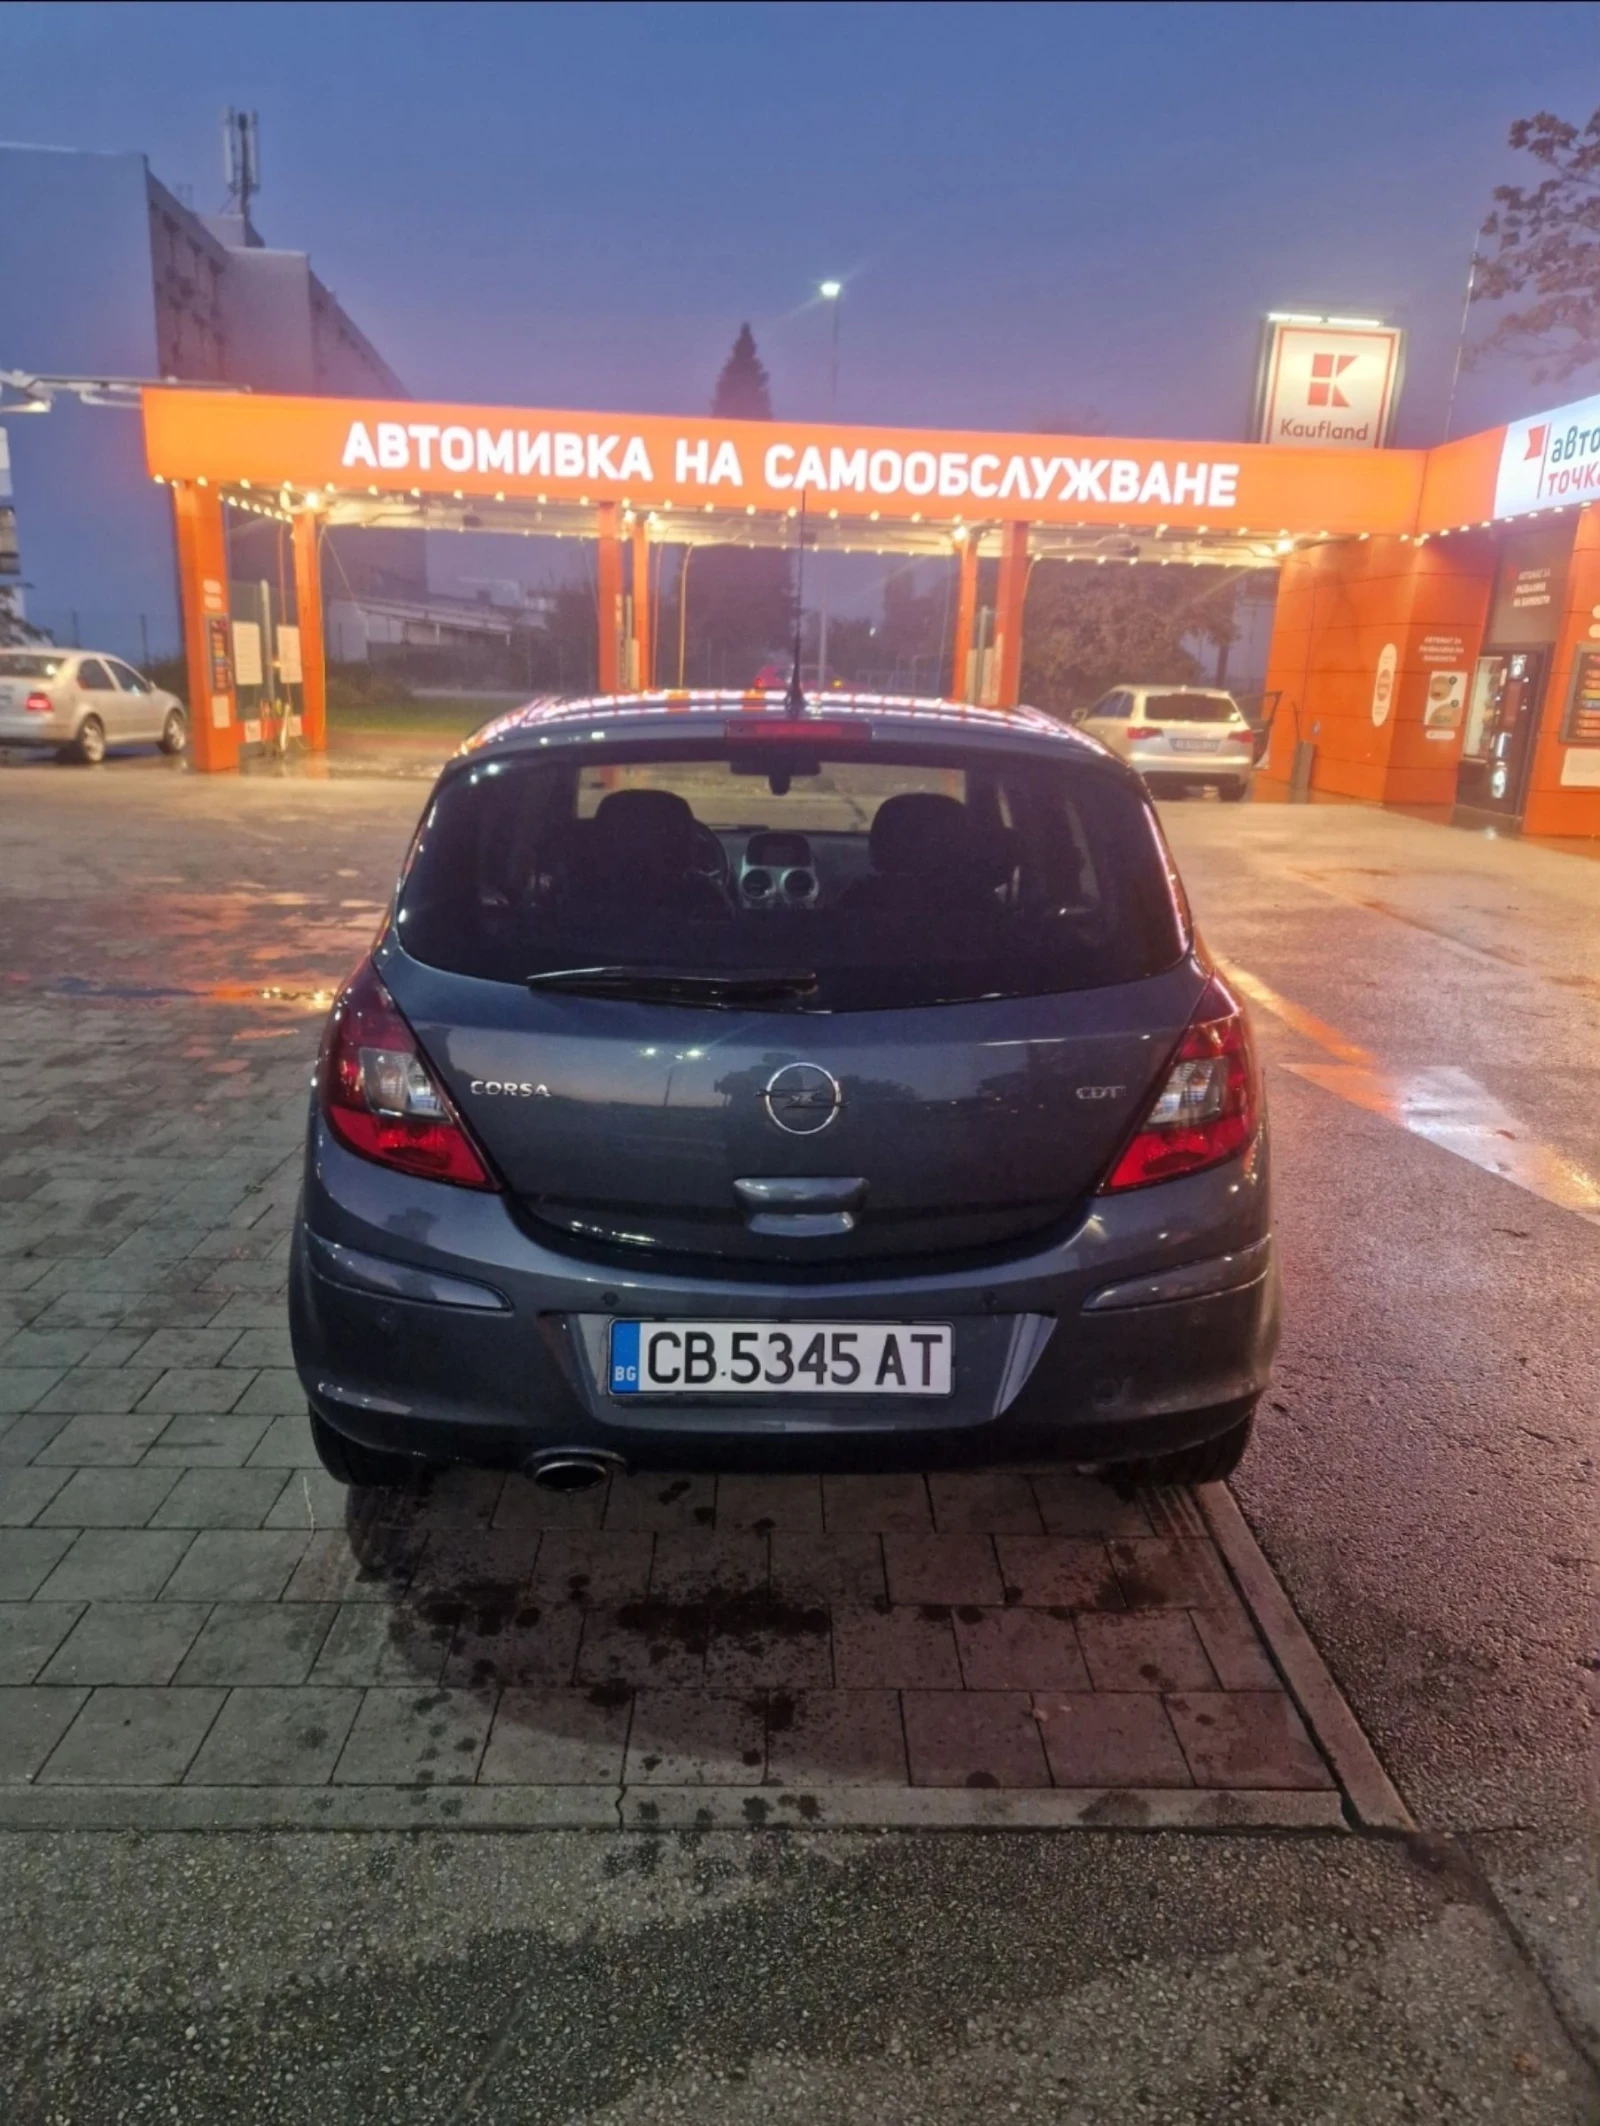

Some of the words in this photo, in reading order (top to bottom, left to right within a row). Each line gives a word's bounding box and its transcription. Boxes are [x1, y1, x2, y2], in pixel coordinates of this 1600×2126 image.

[1280, 418, 1369, 441] Kaufland
[342, 420, 654, 482] АВТОМИВКА
[675, 438, 744, 487] НА
[764, 443, 1240, 507] САМООБСЛУЖВАНЕ
[1548, 461, 1600, 496] точк
[470, 1080, 552, 1098] CORSA
[730, 1332, 861, 1385] 5345
[875, 1334, 944, 1386] AT
[614, 1366, 637, 1382] BG
